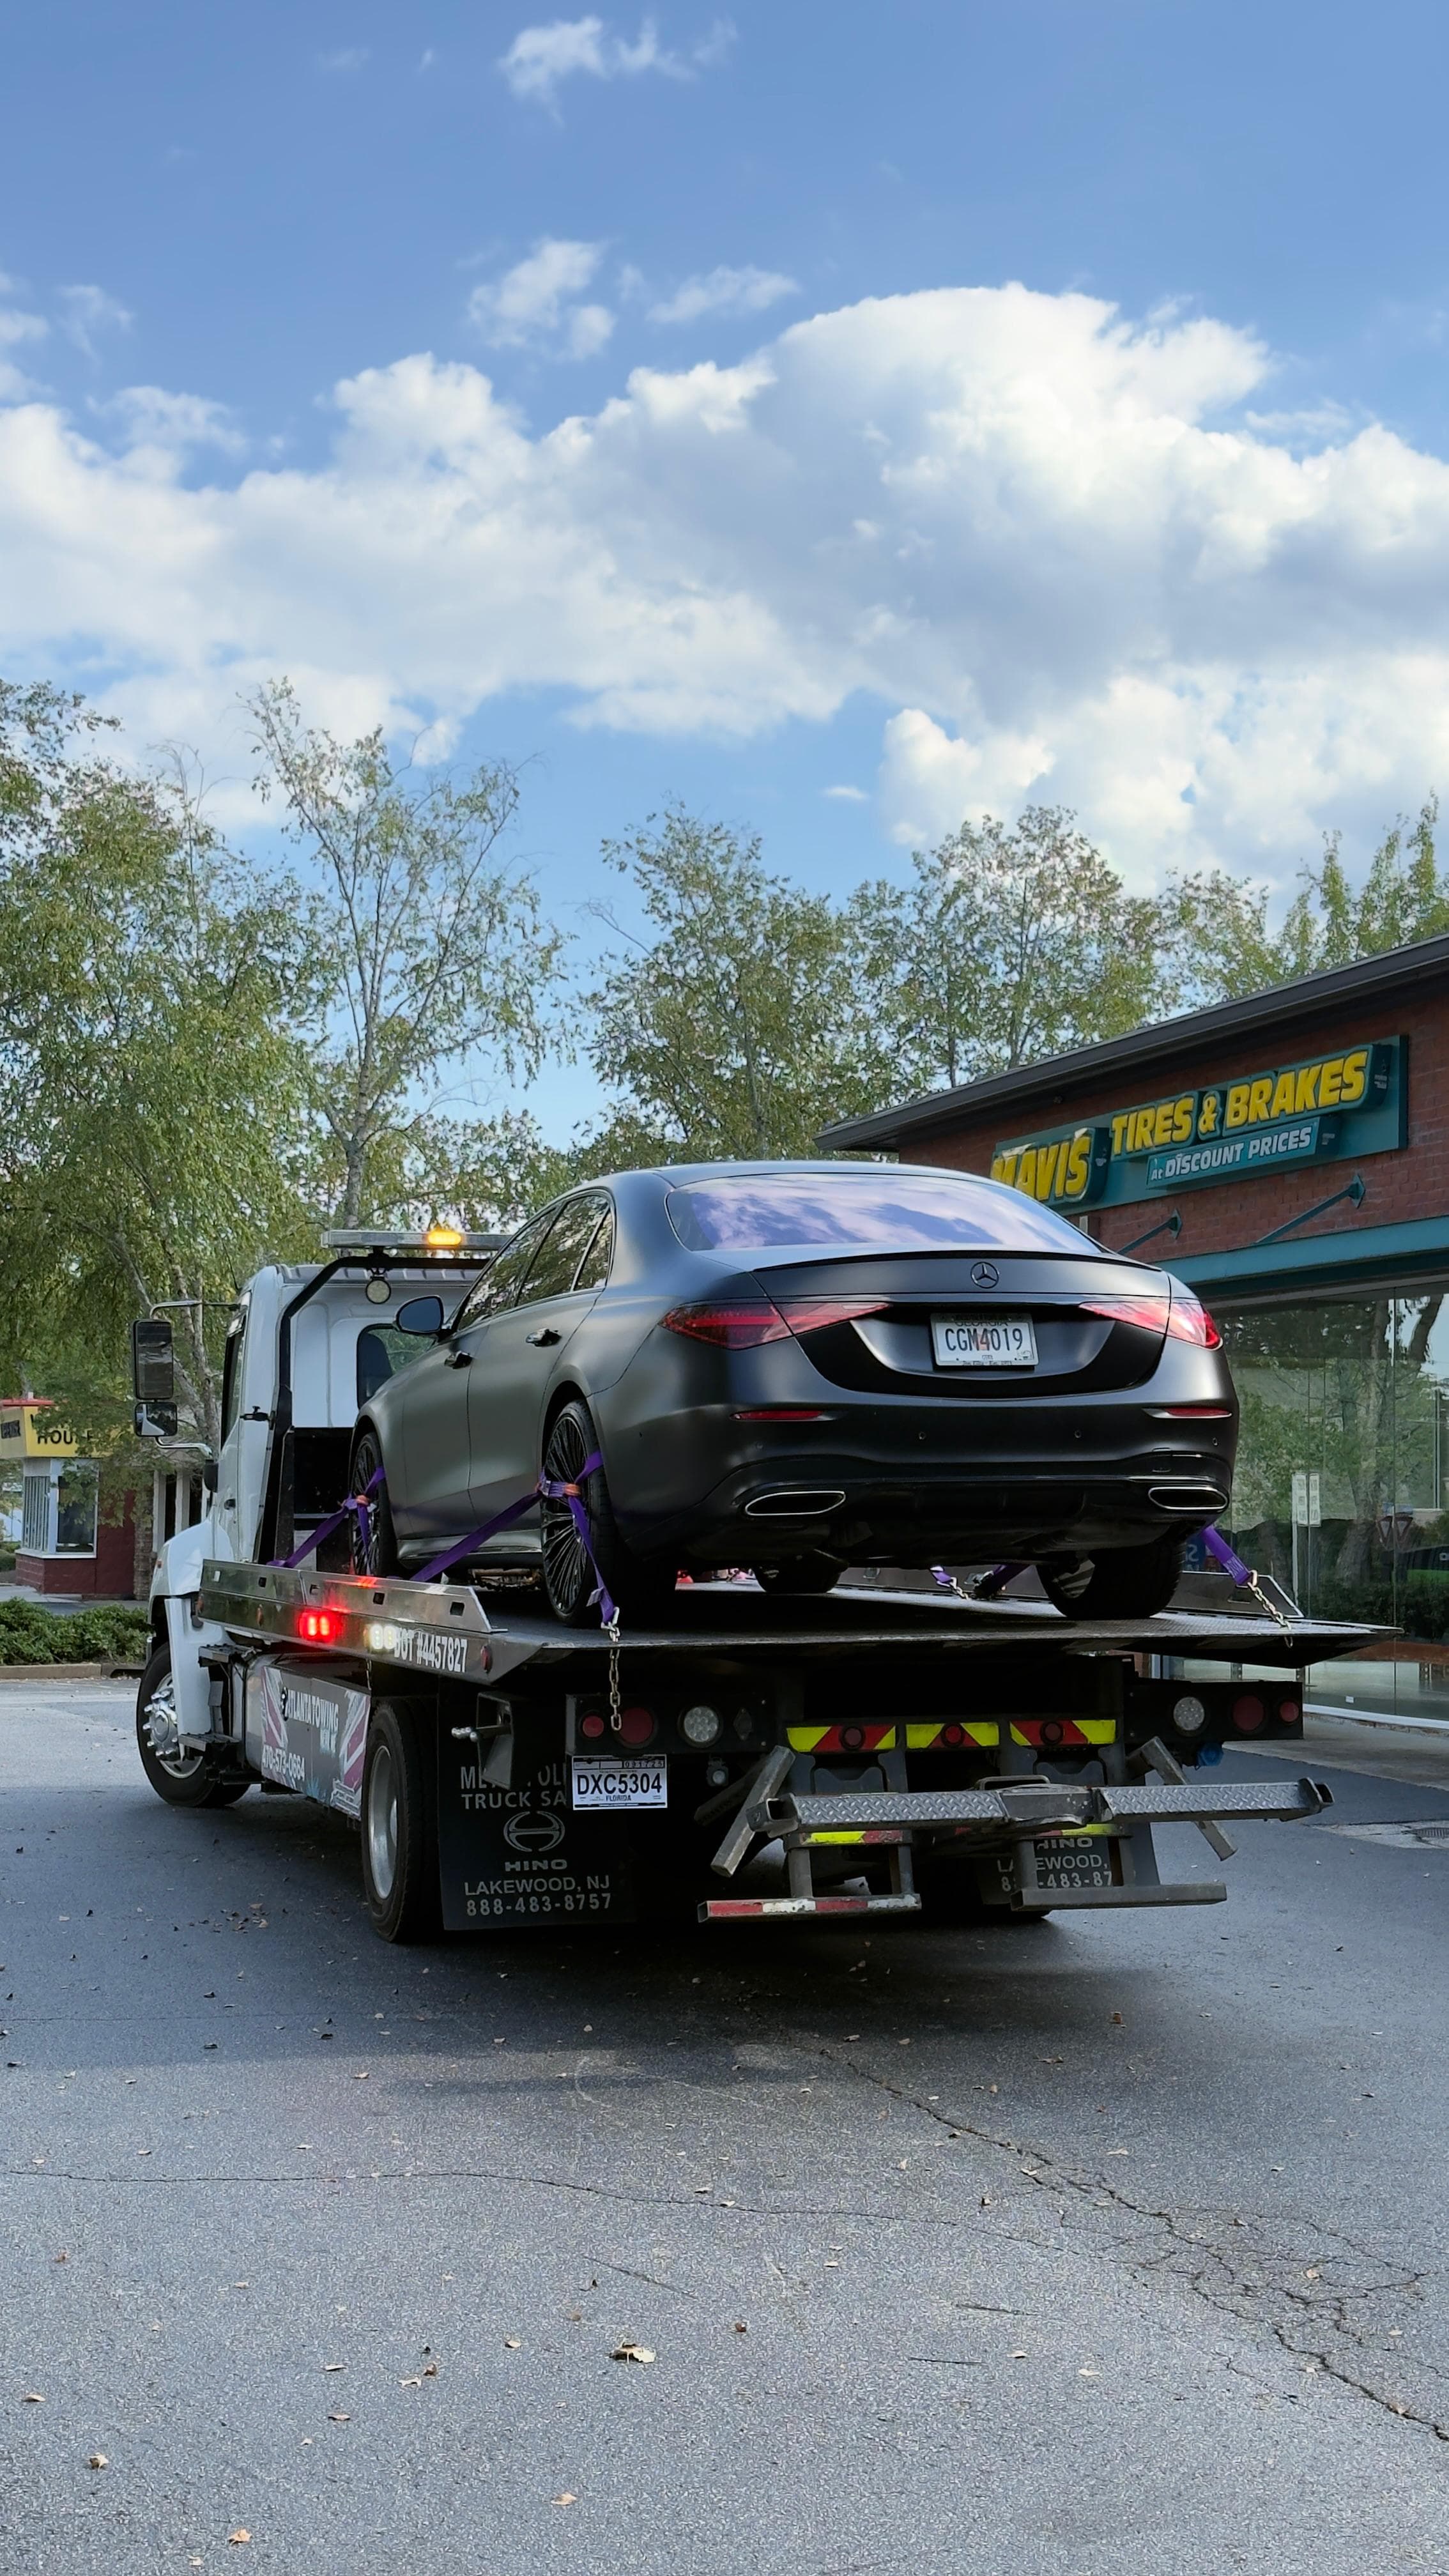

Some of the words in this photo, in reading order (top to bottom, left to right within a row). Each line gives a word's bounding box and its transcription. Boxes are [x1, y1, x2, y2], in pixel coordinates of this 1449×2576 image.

[991, 1137, 1091, 1201] MAVIS
[1112, 1098, 1194, 1155] TIRES
[1198, 1094, 1217, 1133] &
[1226, 1050, 1368, 1129] BRAKES
[1165, 1143, 1245, 1177] DISCOUNT
[1248, 1127, 1312, 1157] PRICES
[945, 1328, 1023, 1351] CGM4019
[417, 1630, 468, 1673] #4457827
[577, 1772, 663, 1795] DXC5304
[461, 1791, 532, 1809] TRUCK
[504, 1859, 568, 1872] HINO
[464, 1877, 581, 1896] LAKEWOOD,
[587, 1875, 610, 1889] NJ
[466, 1892, 611, 1916] 888-483-8757
